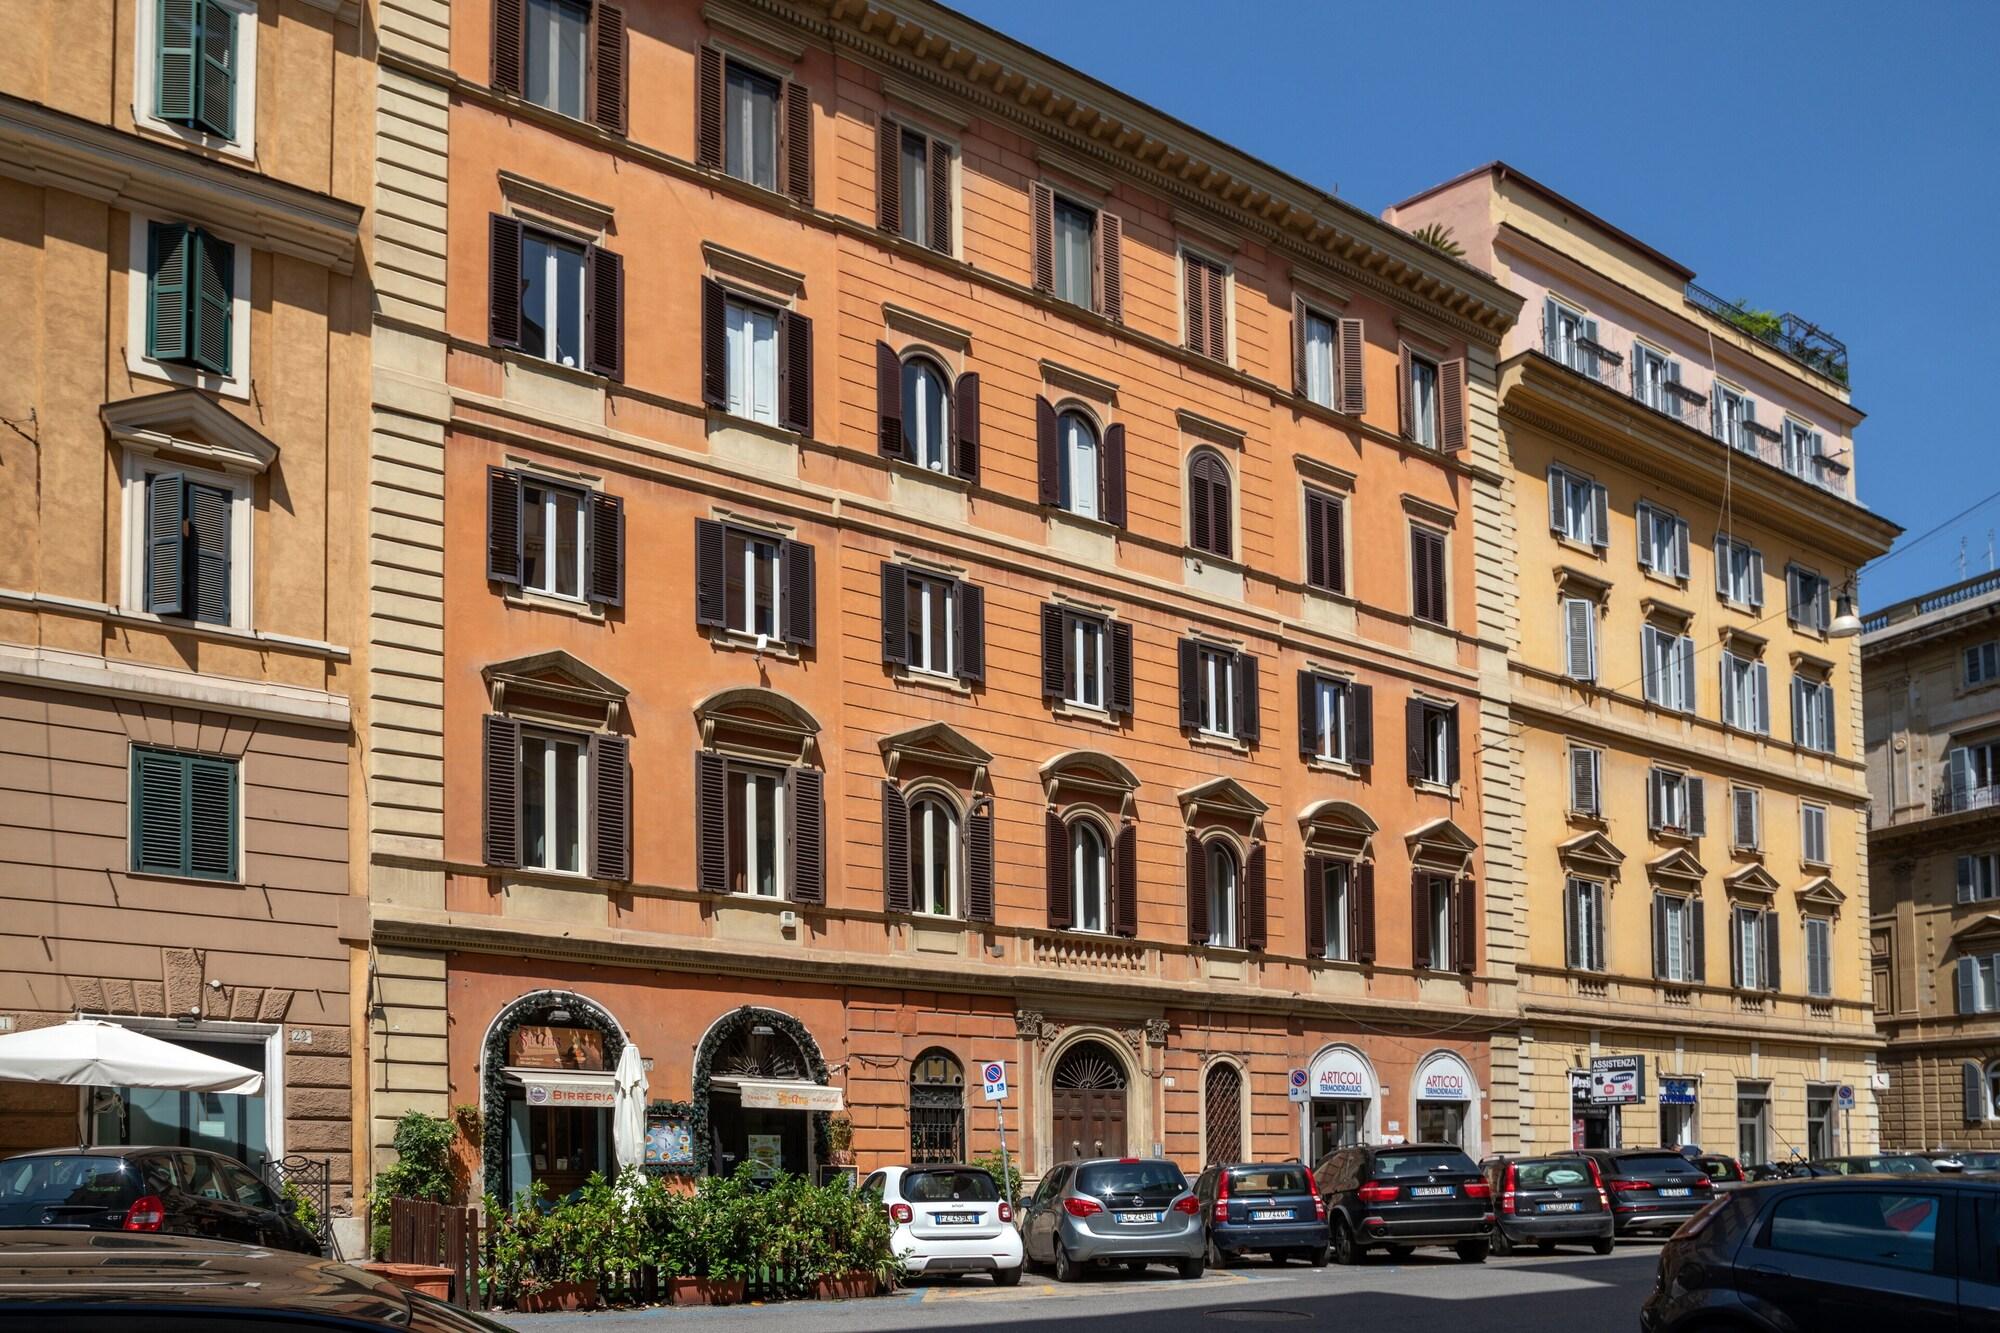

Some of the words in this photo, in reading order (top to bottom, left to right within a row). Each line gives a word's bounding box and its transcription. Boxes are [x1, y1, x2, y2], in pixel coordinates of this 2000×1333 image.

[1593, 1058, 1636, 1069] ASSISTENZA
[1320, 1072, 1361, 1084] ARTICOLI
[1426, 1075, 1463, 1088] ARTICOLI
[552, 1090, 614, 1101] BIRRERIA
